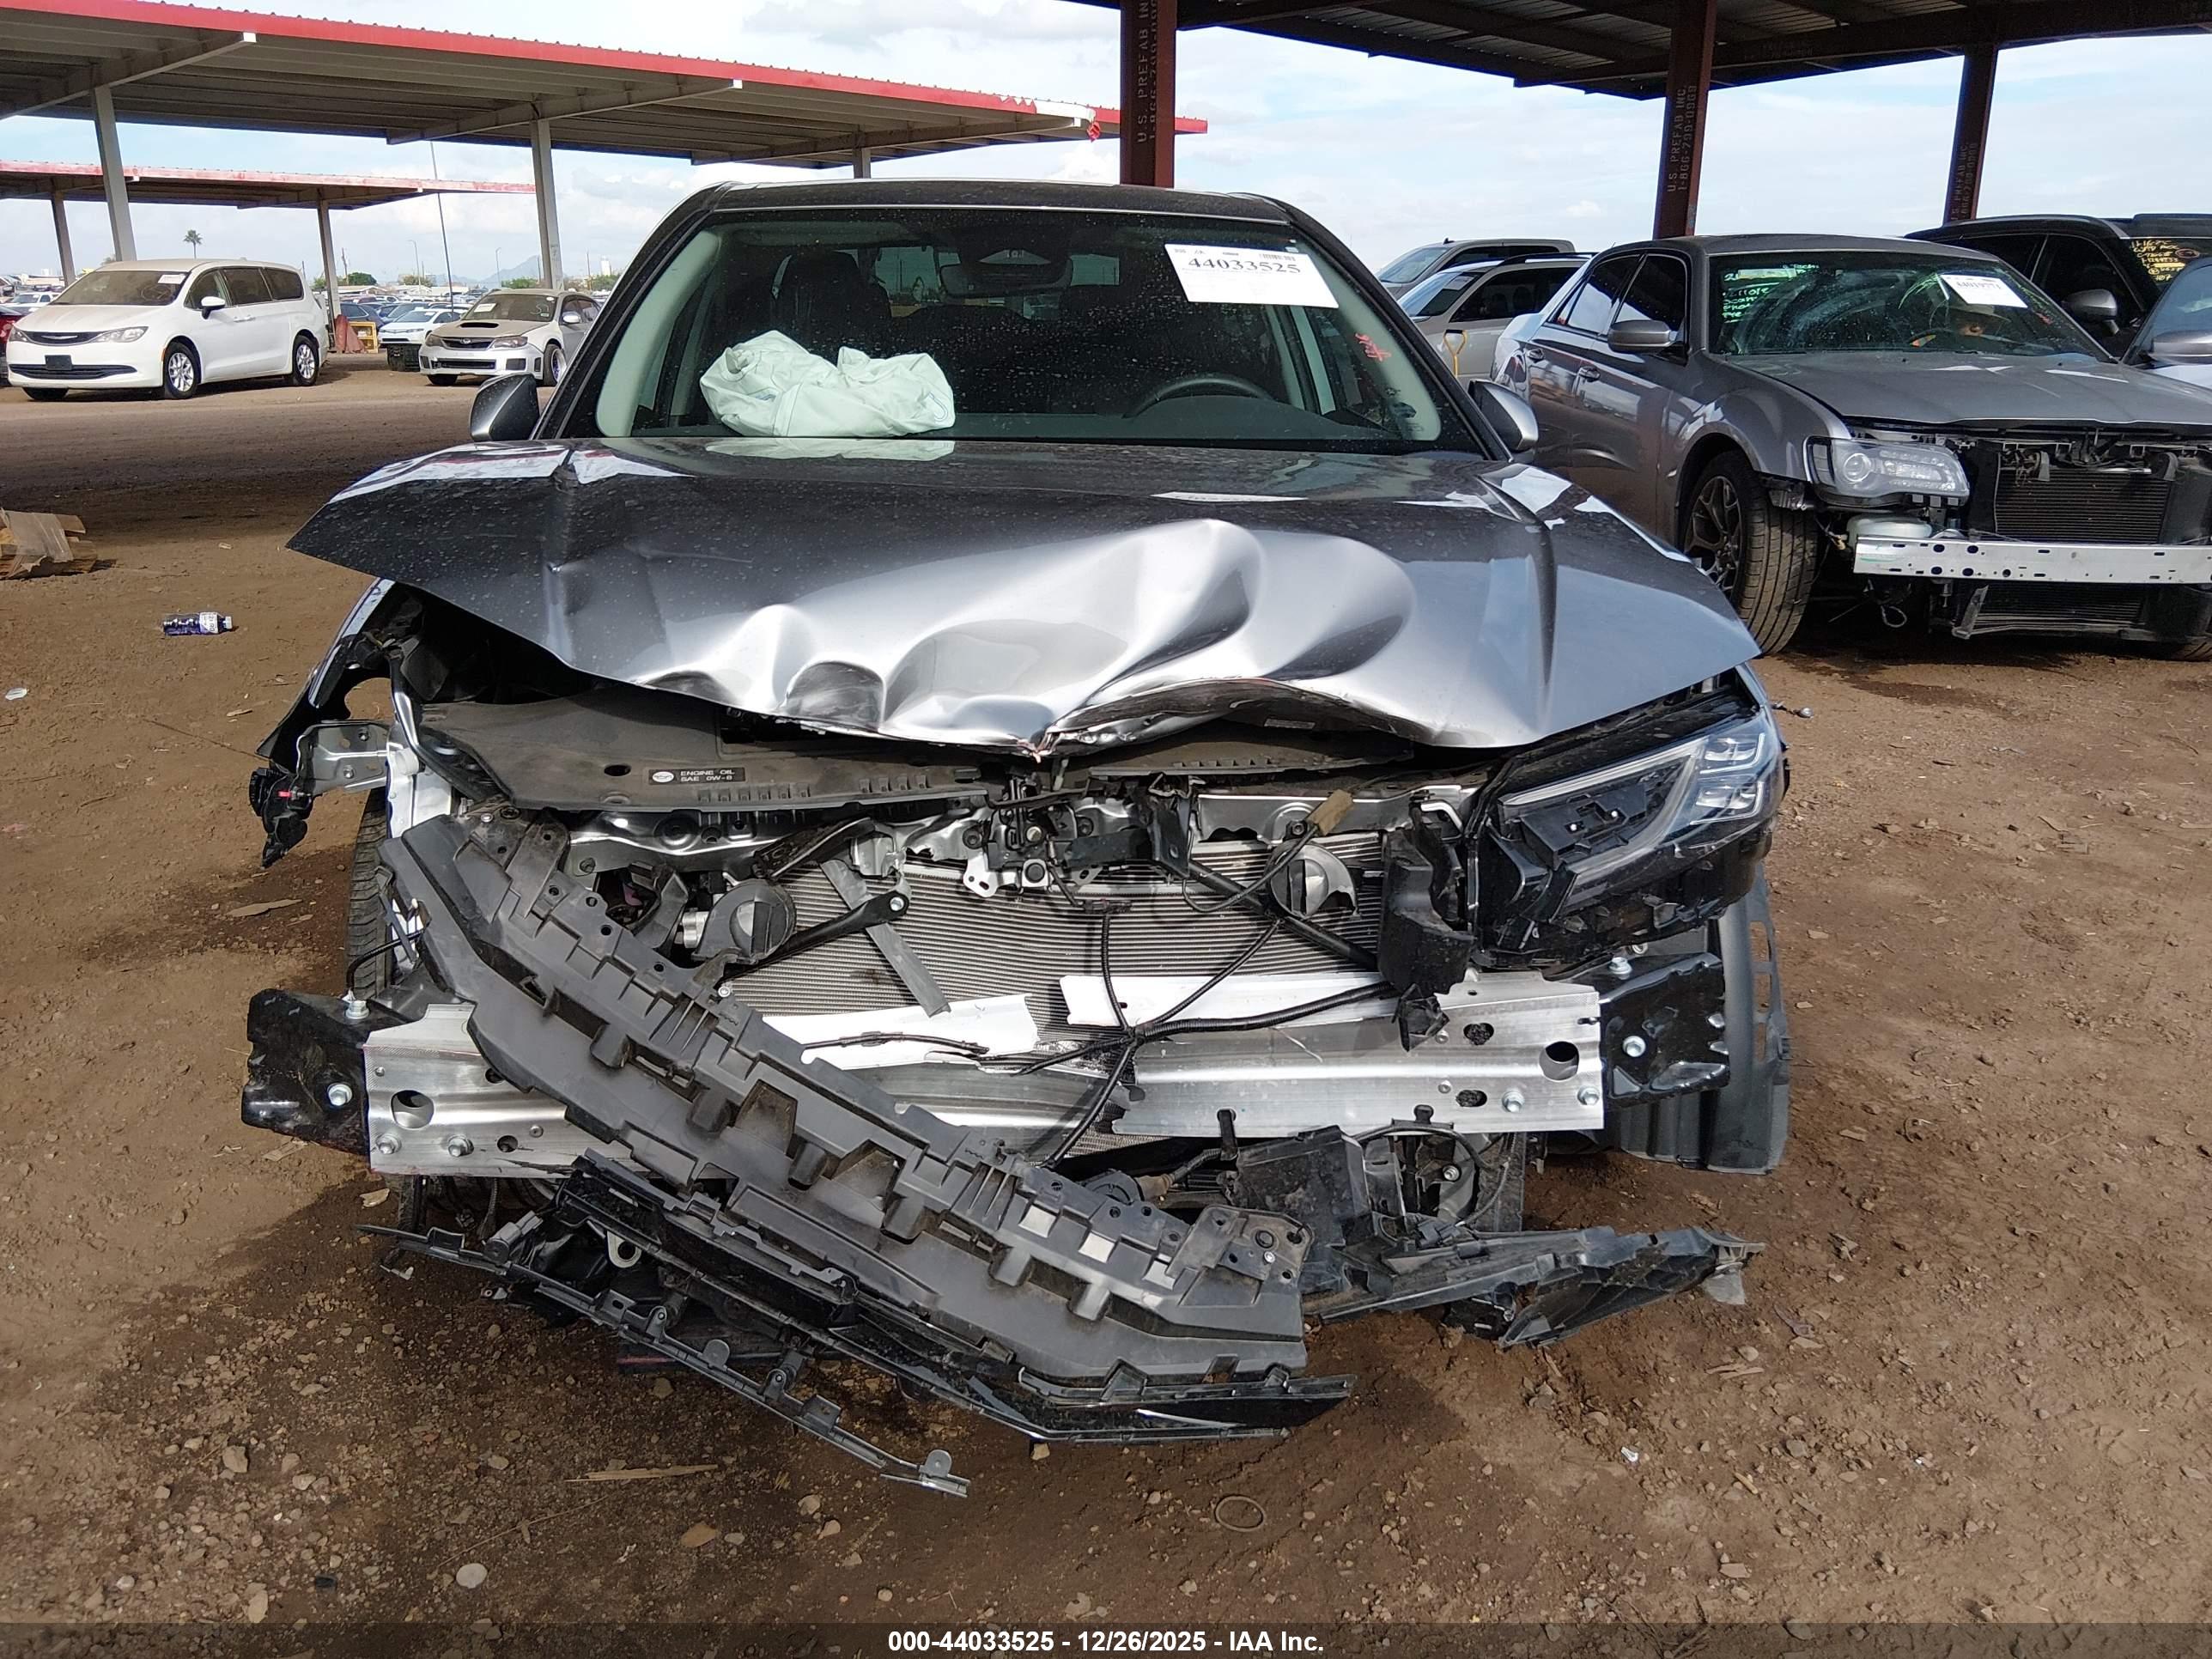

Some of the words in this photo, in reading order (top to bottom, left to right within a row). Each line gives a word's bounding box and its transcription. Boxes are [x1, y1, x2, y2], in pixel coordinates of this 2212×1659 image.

[1137, 28, 1148, 99] PREFAB
[1669, 114, 1685, 163] PREFAB
[1188, 257, 1302, 274] 44033525
